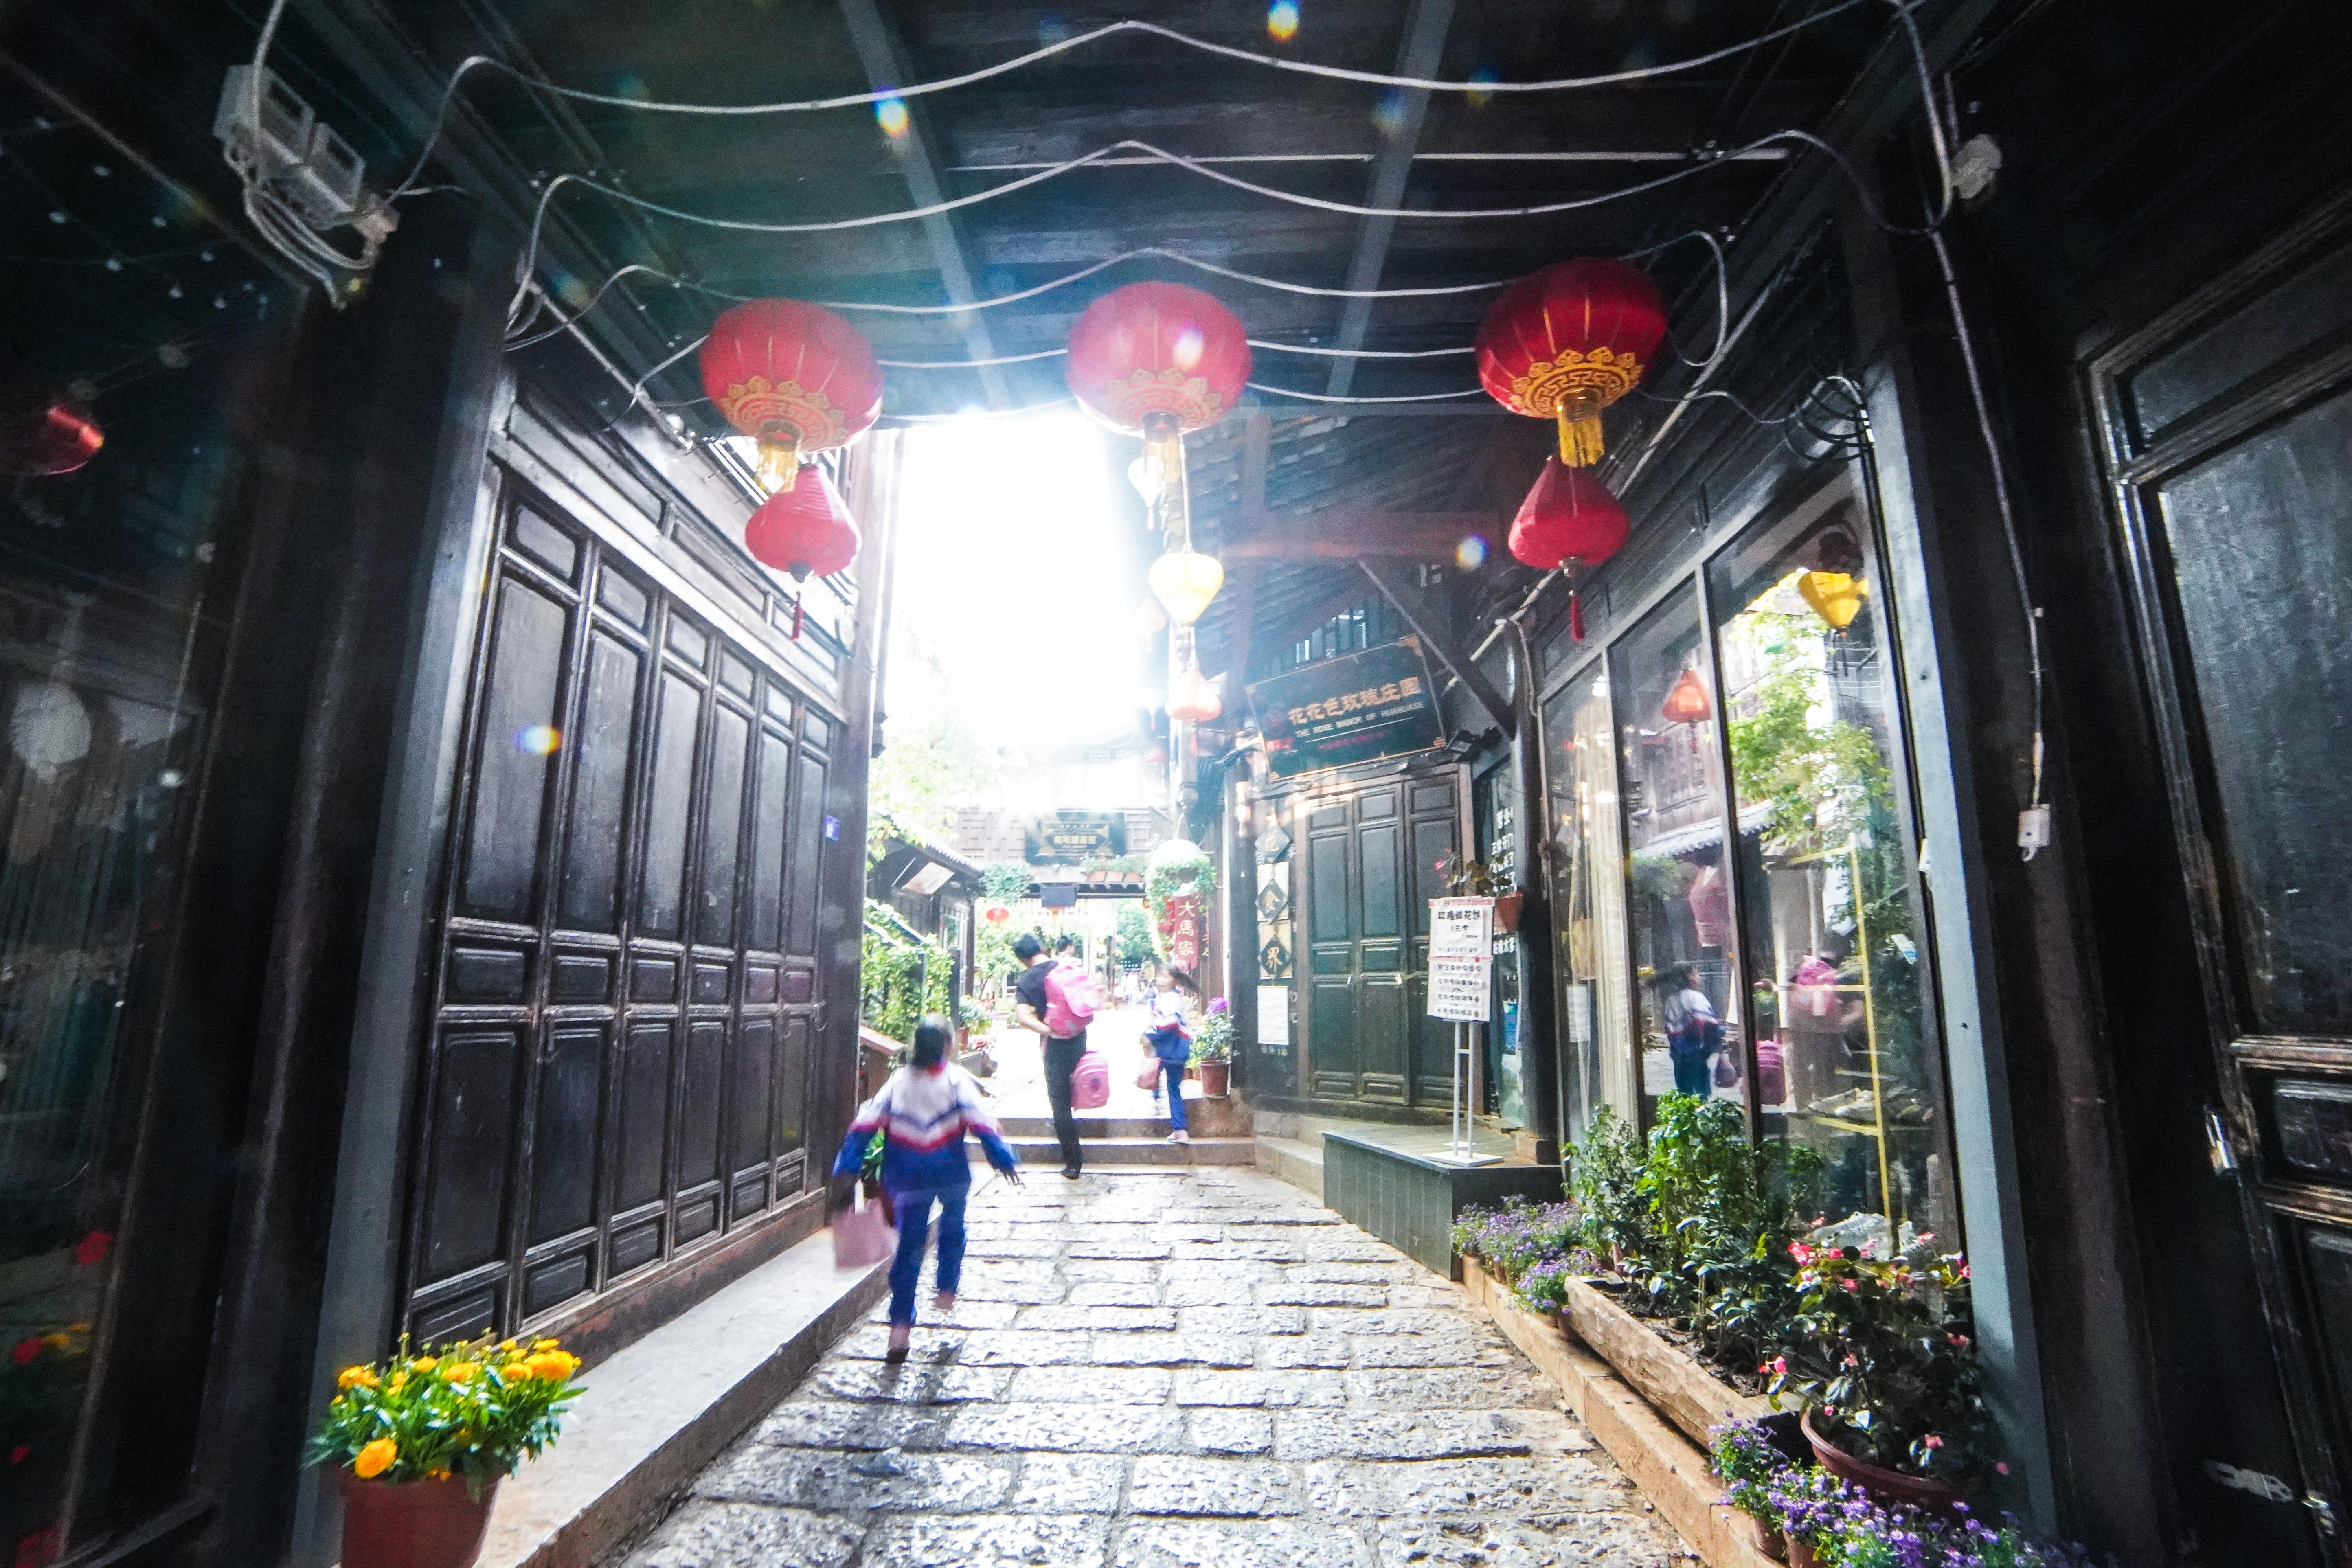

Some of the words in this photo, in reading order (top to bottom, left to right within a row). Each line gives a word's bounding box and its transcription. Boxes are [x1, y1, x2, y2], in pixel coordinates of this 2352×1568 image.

[1288, 676, 1421, 725] 花花色玫瑰庄园
[1294, 729, 1310, 737] THE
[1313, 723, 1334, 734] ROSE
[1365, 713, 1376, 721] OF
